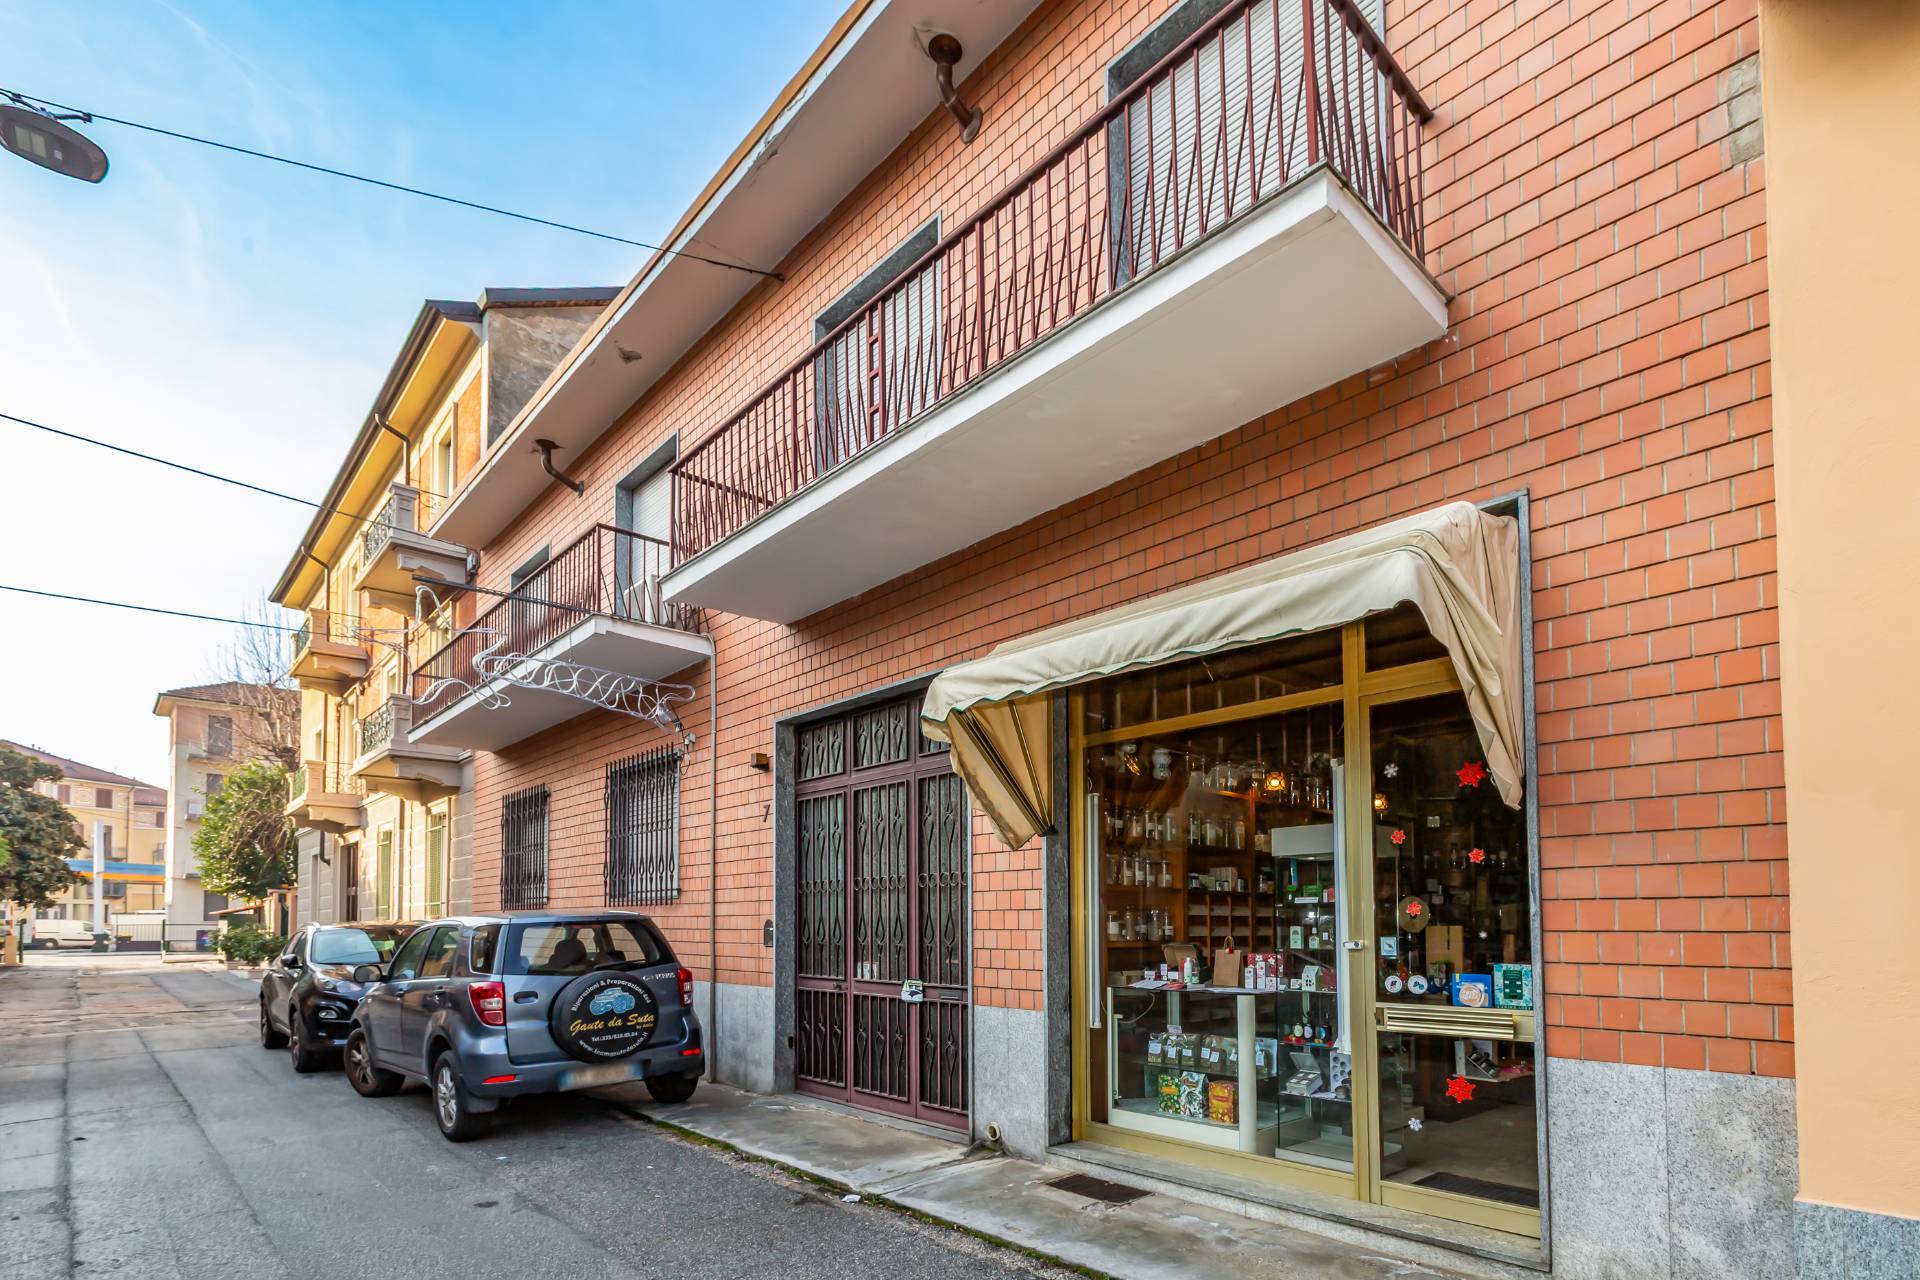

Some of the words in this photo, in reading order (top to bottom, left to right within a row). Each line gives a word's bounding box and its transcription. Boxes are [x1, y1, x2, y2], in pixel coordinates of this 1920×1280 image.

[763, 804, 771, 823] 7
[571, 982, 600, 1011] Riparazioni
[606, 979, 644, 995] Preparazioni
[570, 1019, 605, 1036] Gaute
[608, 1016, 623, 1027] da
[626, 1013, 655, 1026] Suta
